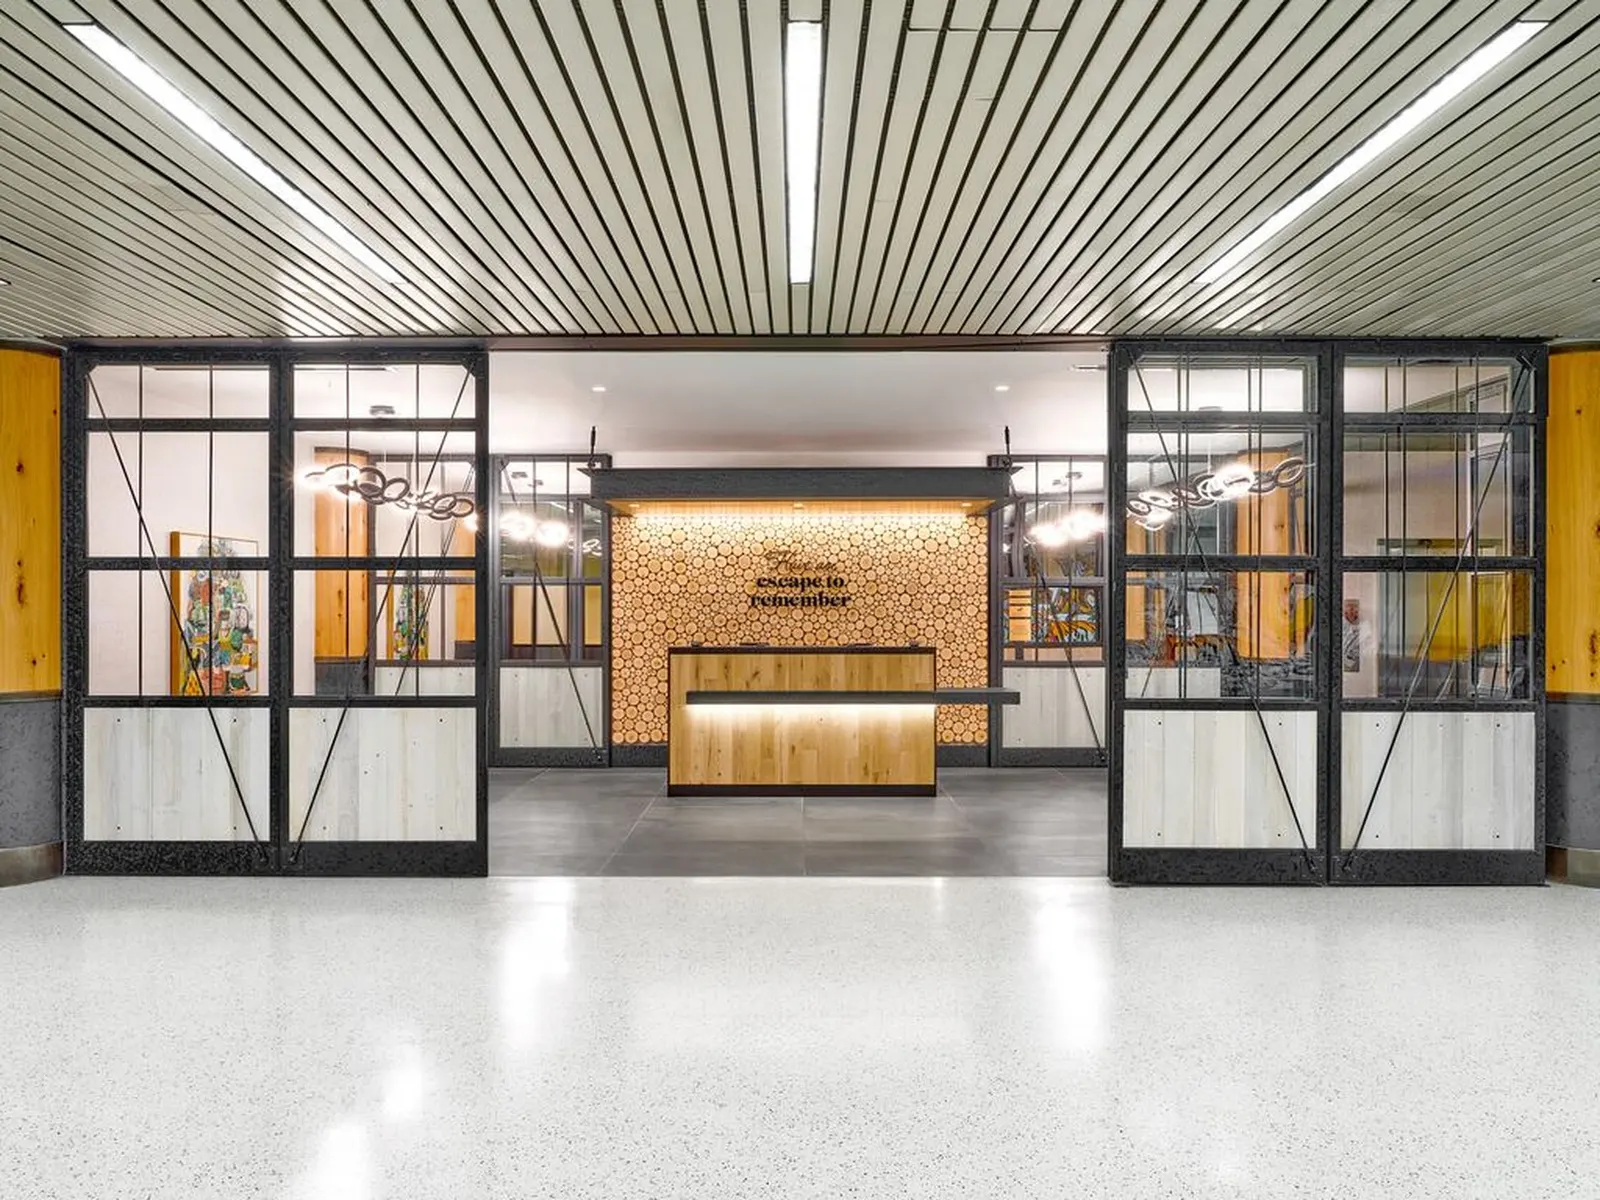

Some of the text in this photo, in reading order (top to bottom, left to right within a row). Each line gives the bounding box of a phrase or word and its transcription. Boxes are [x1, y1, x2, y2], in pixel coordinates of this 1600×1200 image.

[757, 576, 845, 592] escape to
[751, 592, 851, 607] remember
